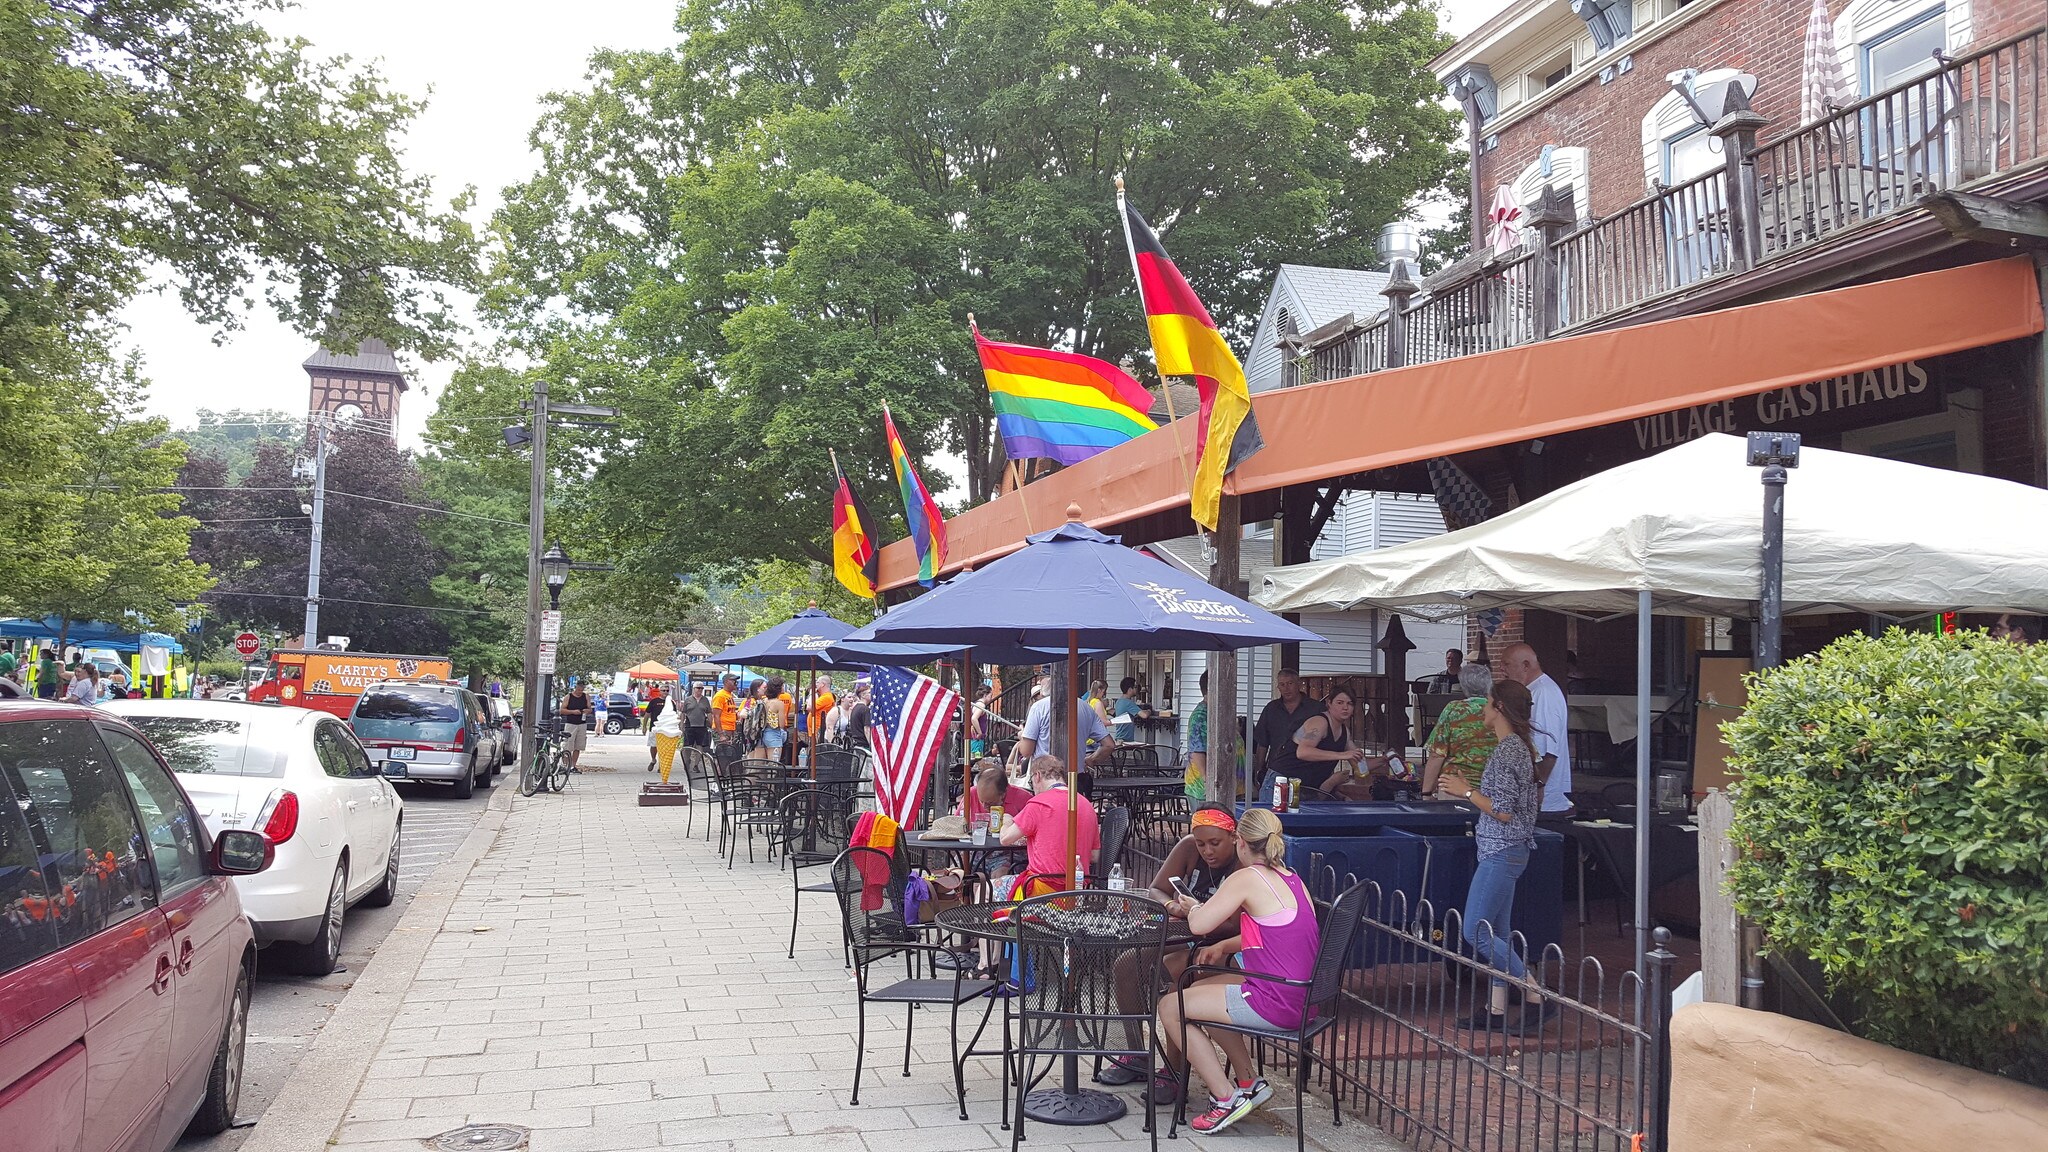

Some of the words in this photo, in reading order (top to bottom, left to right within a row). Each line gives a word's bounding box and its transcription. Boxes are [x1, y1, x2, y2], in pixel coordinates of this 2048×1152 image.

[1633, 400, 1737, 450] VILLAGE
[1756, 360, 1928, 424] GASTHAUS
[236, 639, 258, 648] STOP
[327, 664, 389, 678] MARTY'S
[340, 675, 382, 688] WAFF
